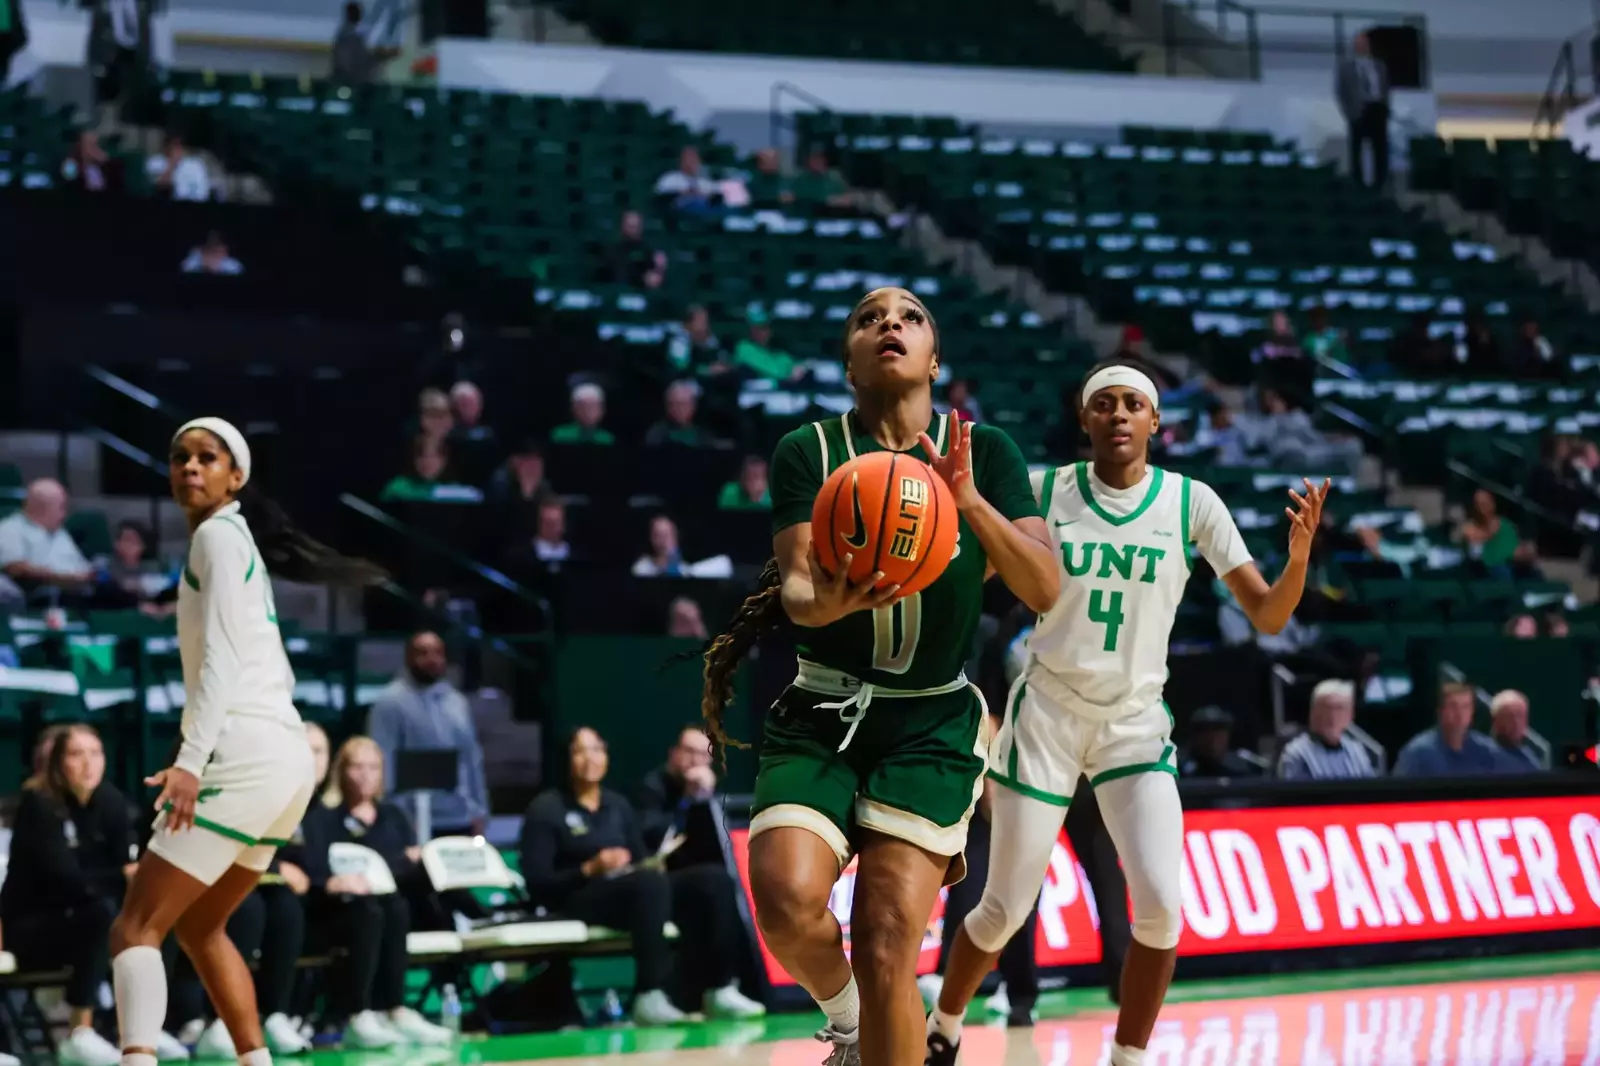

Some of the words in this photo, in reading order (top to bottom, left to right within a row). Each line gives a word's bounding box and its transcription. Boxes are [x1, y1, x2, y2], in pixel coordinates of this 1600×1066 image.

[888, 476, 923, 559] ELITE
[1060, 541, 1166, 584] UNT
[1088, 589, 1124, 652] 4
[1038, 829, 1279, 950] PUD
[1276, 815, 1575, 931] PARTNER
